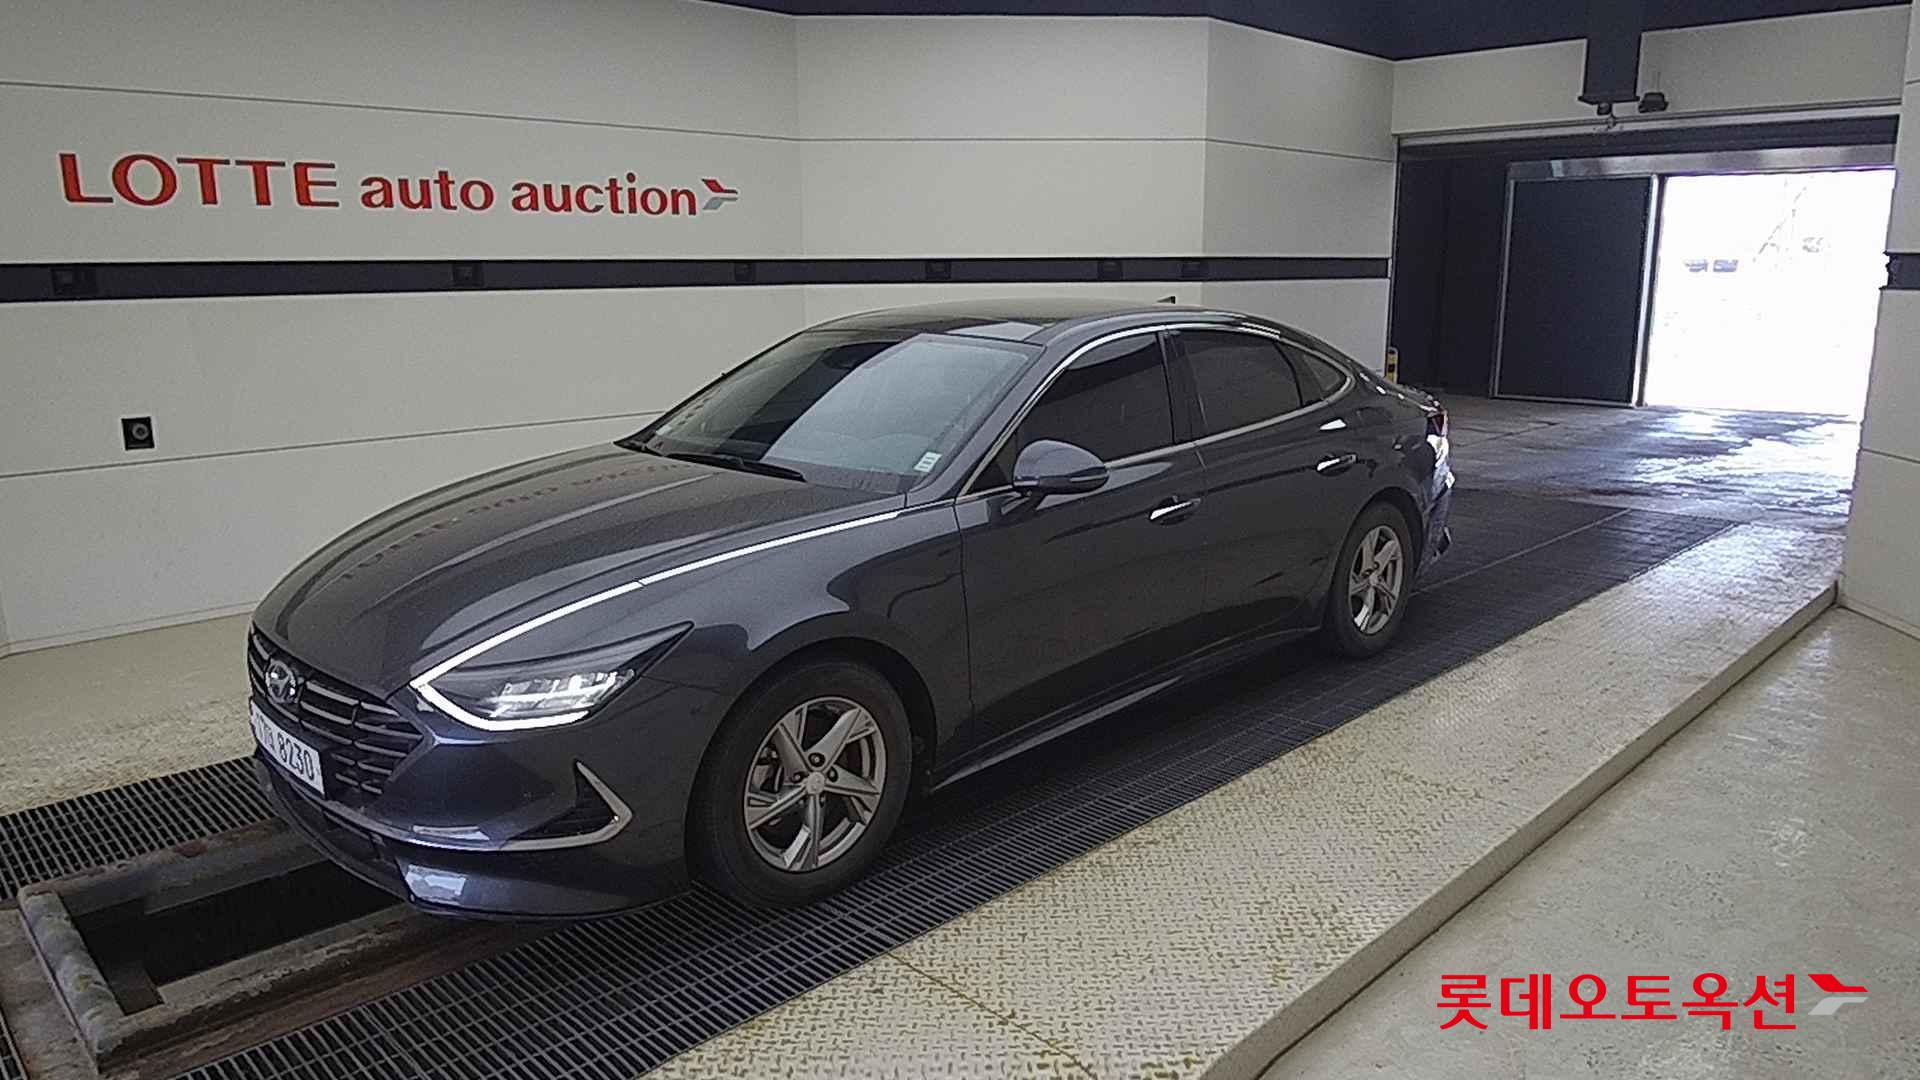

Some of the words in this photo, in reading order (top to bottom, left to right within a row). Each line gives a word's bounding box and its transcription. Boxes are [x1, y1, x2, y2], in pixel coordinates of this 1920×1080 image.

[59, 153, 340, 208] LOTTE
[360, 170, 495, 212] auto
[511, 172, 698, 216] auction
[277, 732, 315, 780] 8230
